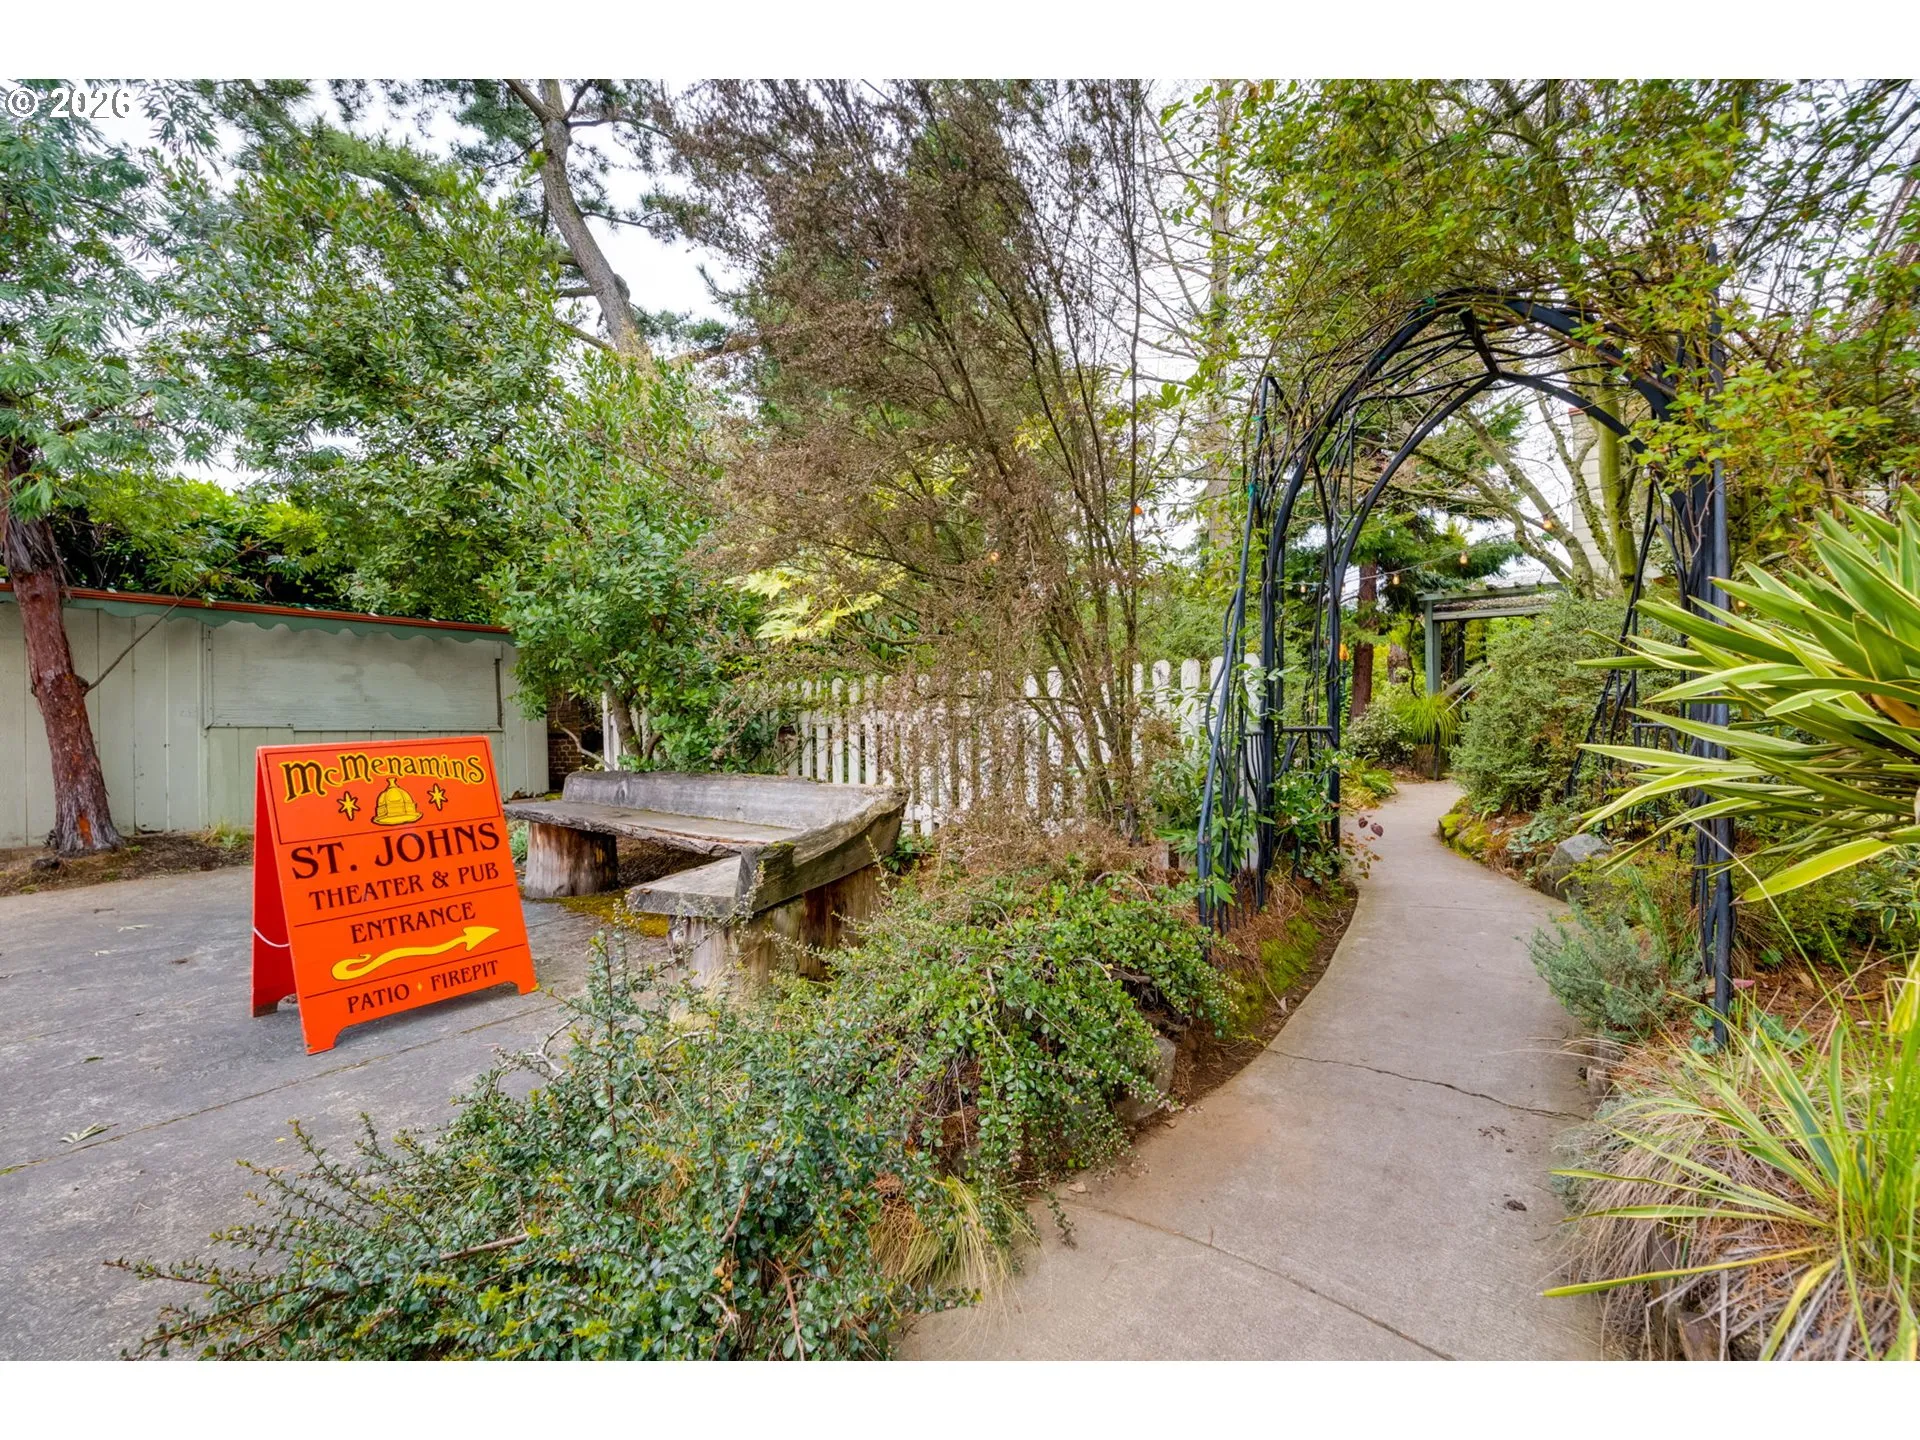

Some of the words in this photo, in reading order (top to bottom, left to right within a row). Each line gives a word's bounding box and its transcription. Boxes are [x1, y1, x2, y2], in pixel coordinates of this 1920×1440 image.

[281, 752, 486, 803] McMenamins
[290, 841, 358, 880] ST.
[374, 822, 500, 867] JOHNS
[308, 874, 424, 911] THEATER
[431, 870, 449, 889] &
[458, 861, 500, 884] PUB
[350, 901, 477, 944] ENTRANCE
[346, 983, 411, 1014] PATIO
[430, 959, 499, 992] FIREPIT
